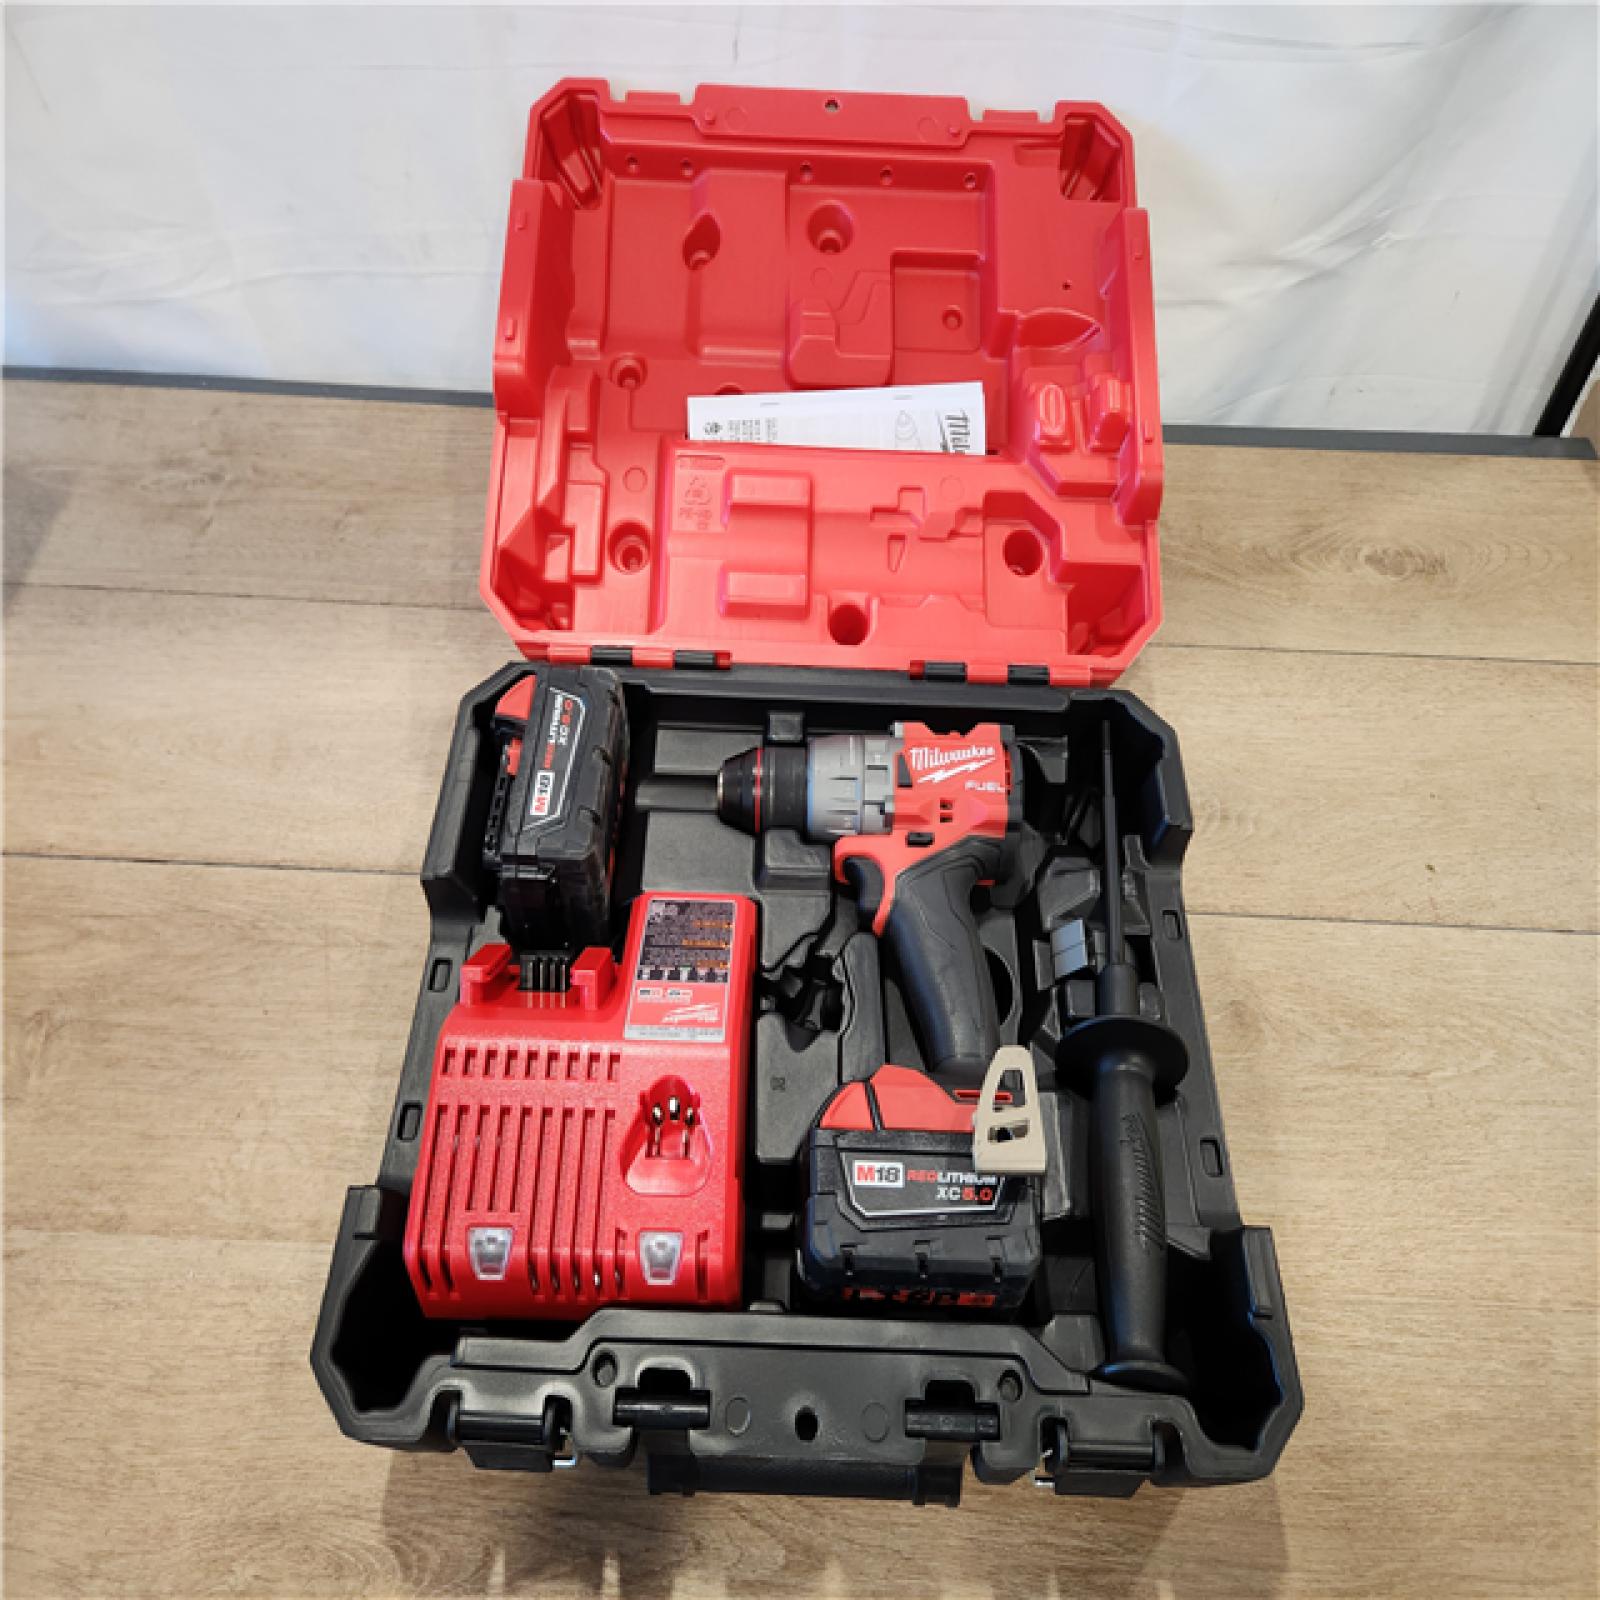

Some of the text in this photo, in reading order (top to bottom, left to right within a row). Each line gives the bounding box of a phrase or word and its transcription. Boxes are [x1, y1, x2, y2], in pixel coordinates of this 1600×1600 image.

[909, 744, 995, 771] Milwaukee
[964, 781, 1006, 793] FUEL
[856, 1164, 900, 1184] M18
